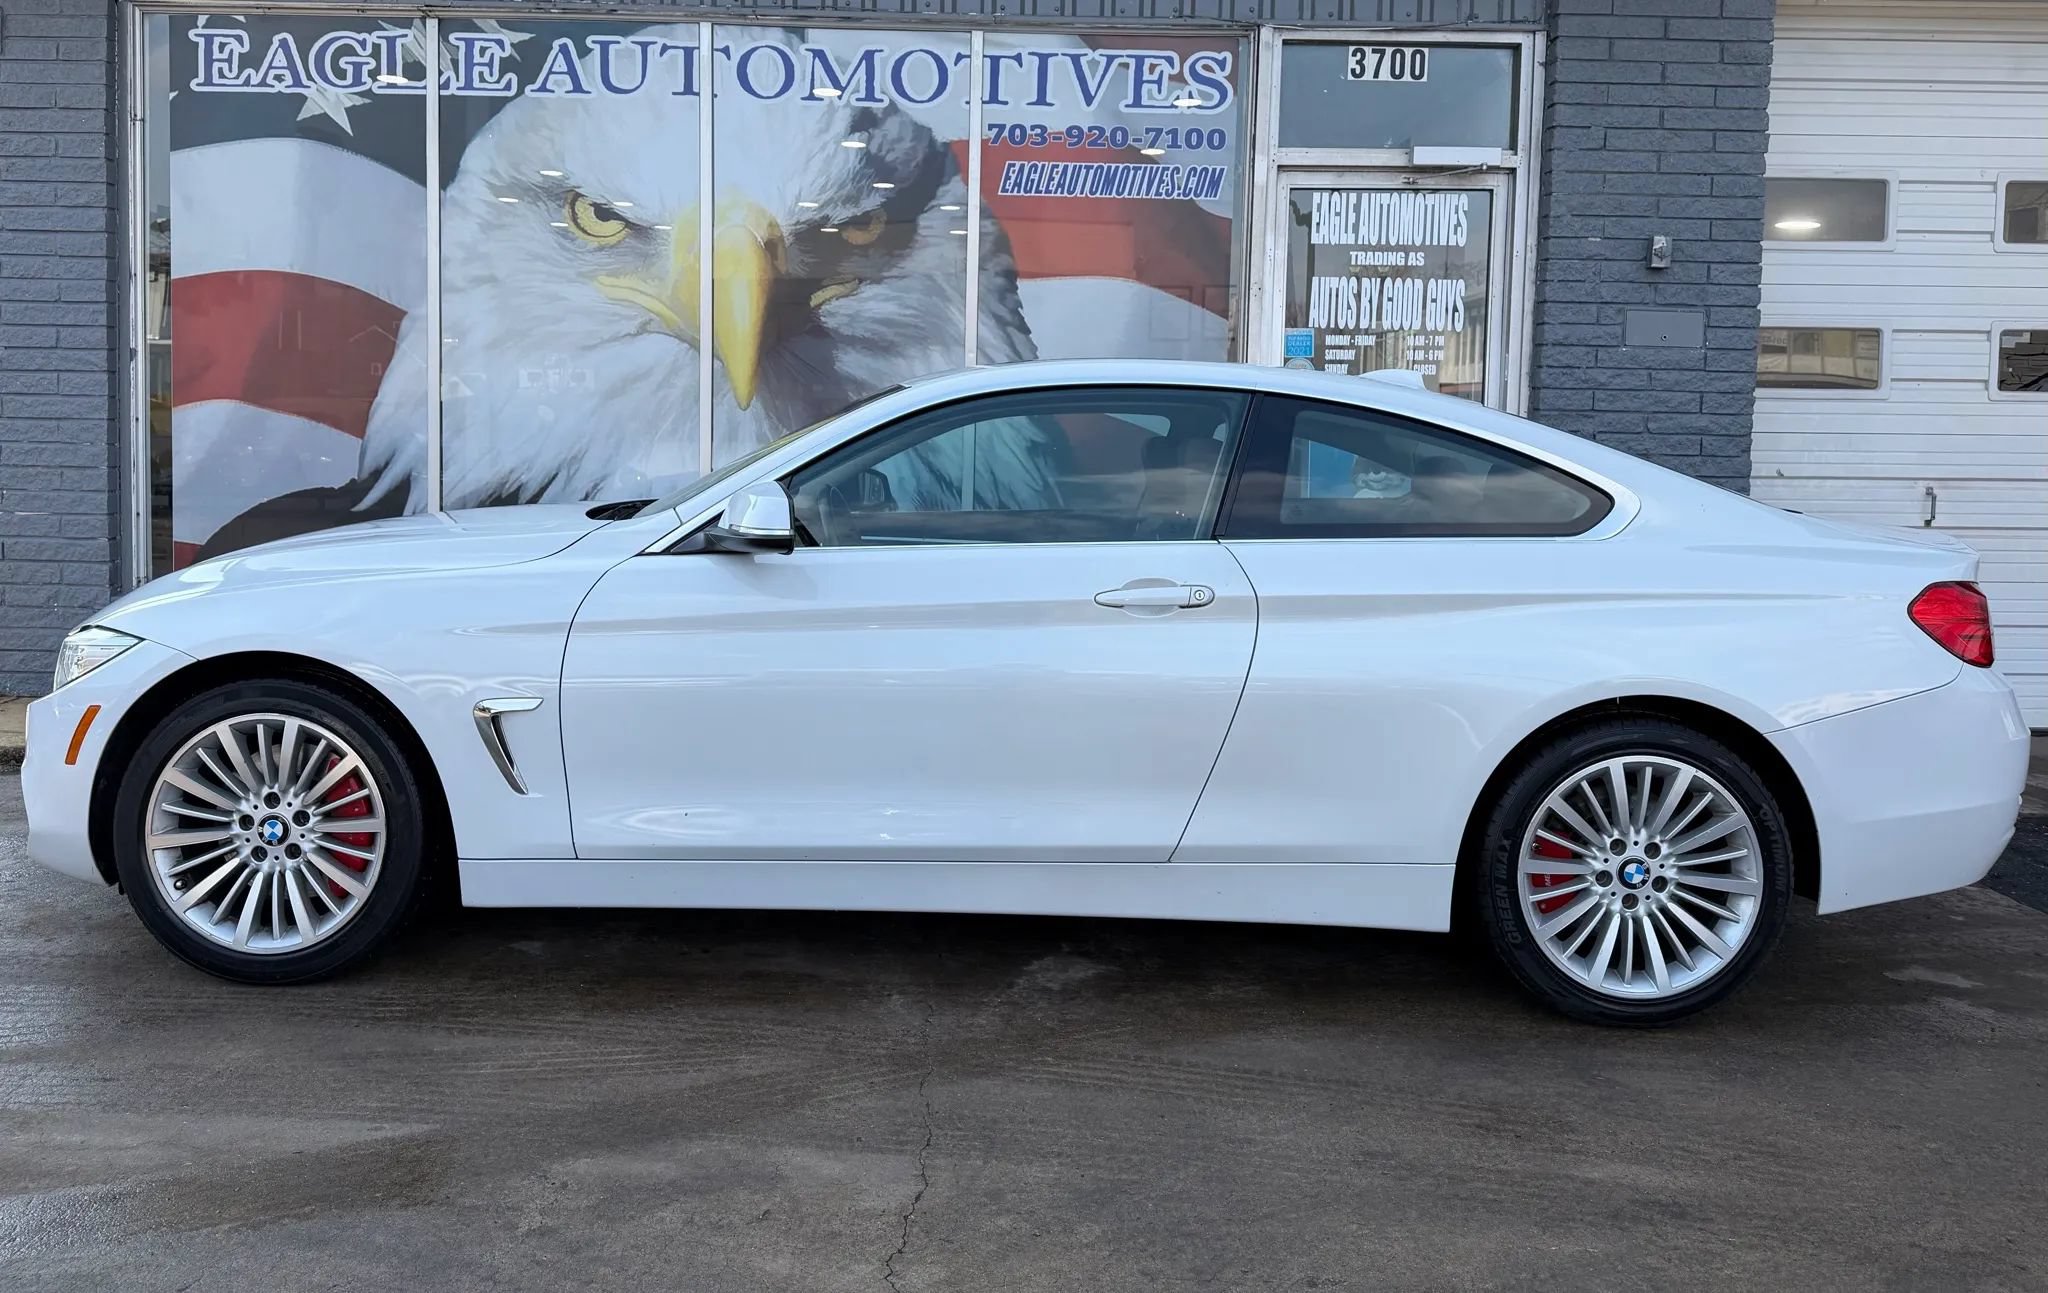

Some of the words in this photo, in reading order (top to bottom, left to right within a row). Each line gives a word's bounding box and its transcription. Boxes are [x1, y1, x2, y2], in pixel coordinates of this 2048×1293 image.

[1350, 47, 1426, 81] 3700
[188, 28, 517, 96] EAGLE
[527, 36, 1236, 114] AUTOMOTIVES
[987, 122, 1228, 152] 703-920-7100
[998, 161, 1225, 200] EAGLEAUTOMOTIVES.COM
[1310, 192, 1357, 245] EAGLE
[1357, 192, 1469, 247] AUTOMOTIVES
[1350, 251, 1405, 266] TRADING
[1407, 252, 1425, 266] AS
[1308, 276, 1358, 329] AUTOS
[1359, 277, 1381, 330] BY
[1382, 277, 1424, 331] GOOD
[1425, 278, 1466, 332] GUYS
[1325, 335, 1351, 346] MONDAY
[1354, 335, 1376, 346] FRIDAY
[1407, 336, 1414, 346] 10
[1414, 336, 1425, 347] AM
[1434, 336, 1445, 347] PM
[1288, 347, 1310, 356] 2021
[1325, 349, 1356, 361] SATURDAY
[1407, 350, 1414, 360] 10
[1414, 350, 1424, 360] AM
[1428, 350, 1434, 360] 6
[1434, 350, 1444, 361] PM
[1325, 363, 1349, 375] SUNDAY
[1413, 364, 1437, 376] CLOSED
